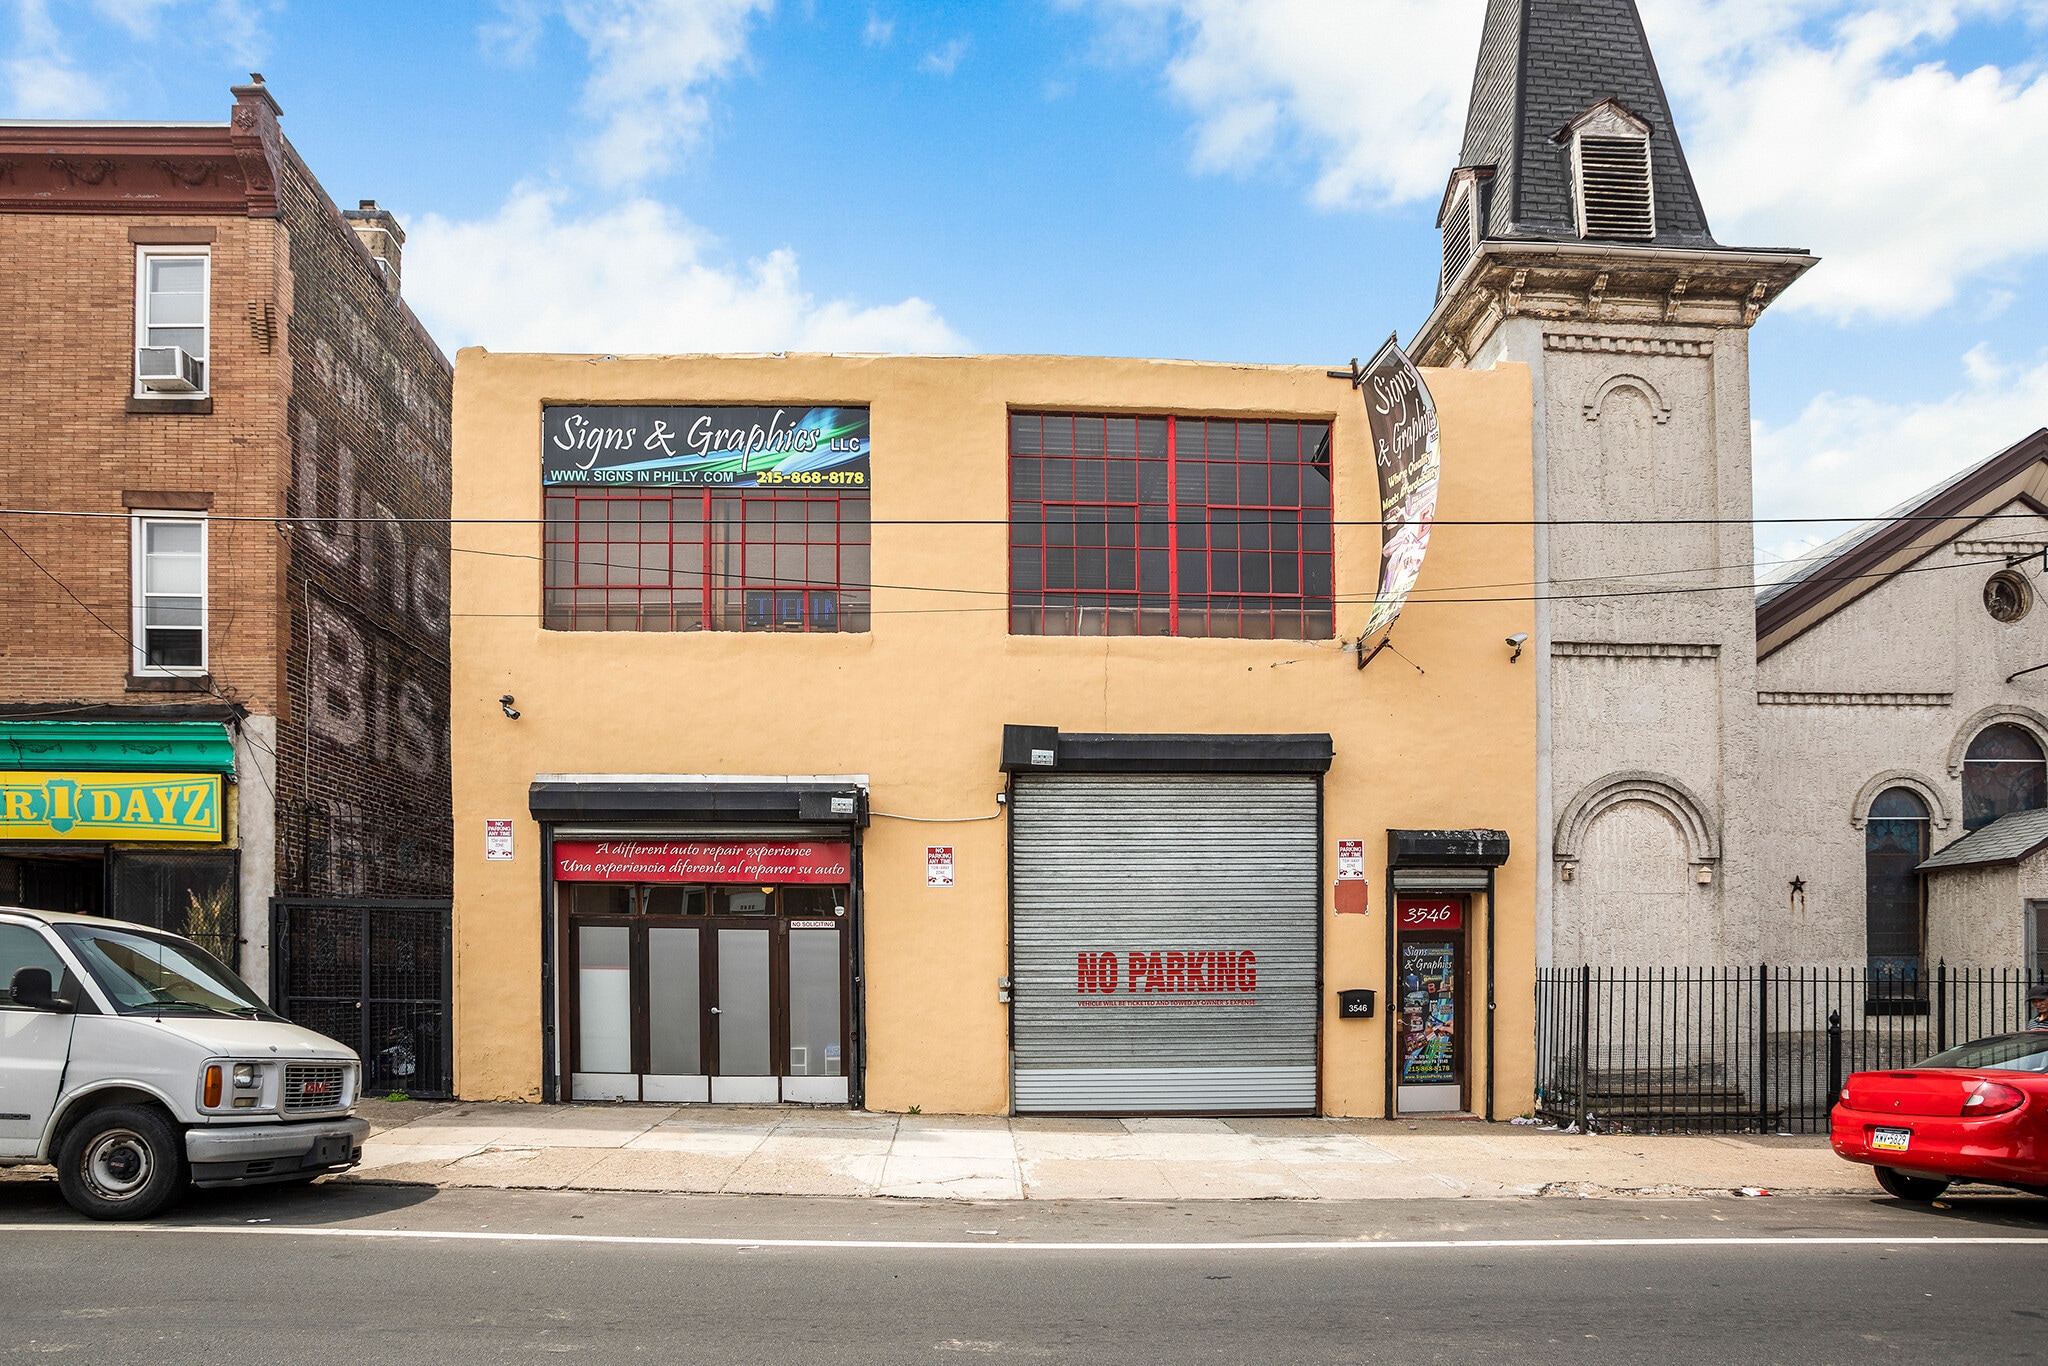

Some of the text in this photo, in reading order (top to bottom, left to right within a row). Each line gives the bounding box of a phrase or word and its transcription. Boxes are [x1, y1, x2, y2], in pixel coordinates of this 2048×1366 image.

[1374, 364, 1416, 427] Signs
[553, 409, 860, 472] Signs & Graphics LLC
[1378, 398, 1438, 467] & Graphics
[550, 470, 590, 482] WWW.
[593, 471, 634, 482] SIGNS
[637, 471, 649, 482] IN
[653, 471, 698, 482] PHILLY
[756, 470, 865, 484] 215-868-8178
[595, 841, 812, 862] A different auto repair experience
[560, 858, 845, 880] Una experiencia diferente al reparar su auto
[1403, 905, 1451, 924] 3546
[1404, 945, 1428, 962] Signs
[1077, 950, 1257, 994] NO PARKING
[1404, 956, 1453, 975] & Graphics
[1348, 1004, 1368, 1012] 3546
[303, 1082, 331, 1094] GMC
